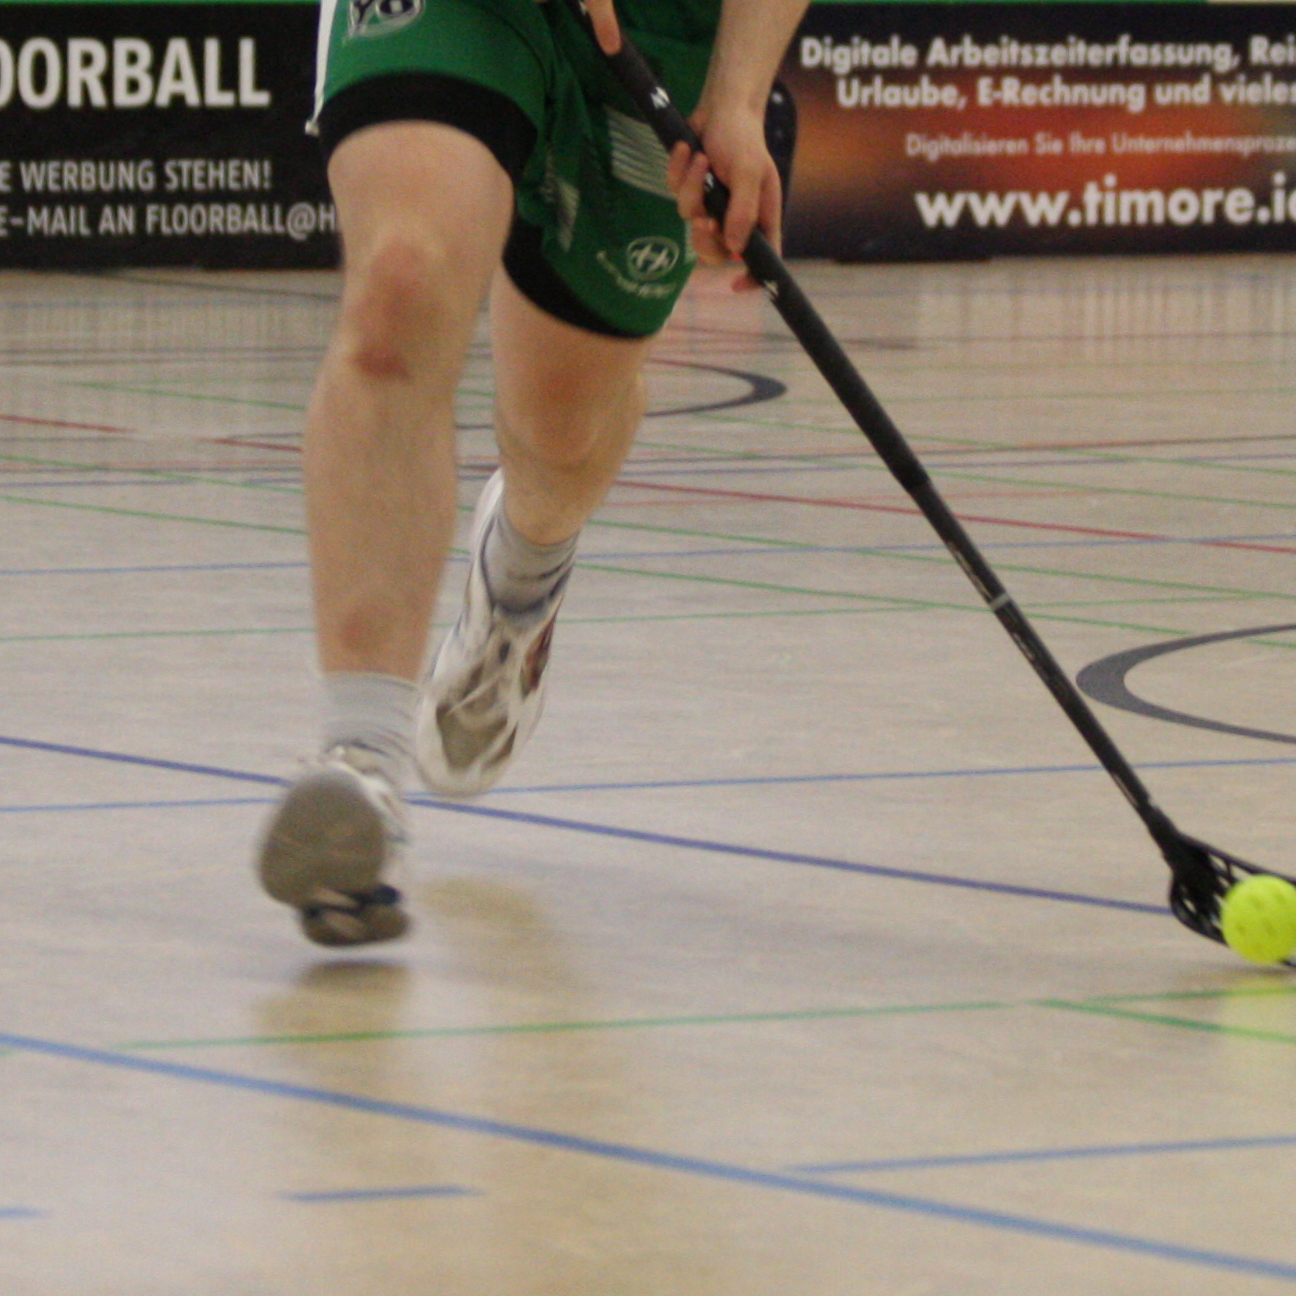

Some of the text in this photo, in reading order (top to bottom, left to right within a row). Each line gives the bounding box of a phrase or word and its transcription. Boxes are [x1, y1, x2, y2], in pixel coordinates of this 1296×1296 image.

[800, 34, 918, 75] Digitale
[925, 33, 1241, 74] Arbeitszeiterfassung,
[836, 73, 968, 111] Urlaube,
[976, 72, 1147, 114] E-Rechnung
[1155, 72, 1212, 105] und
[906, 131, 1029, 163] Digitalisieren
[1034, 131, 1064, 155] Sie
[1069, 131, 1106, 155] Ihre
[19, 159, 157, 193] WERBUNG
[164, 158, 273, 191] STEHEN!
[98, 204, 135, 235] AN
